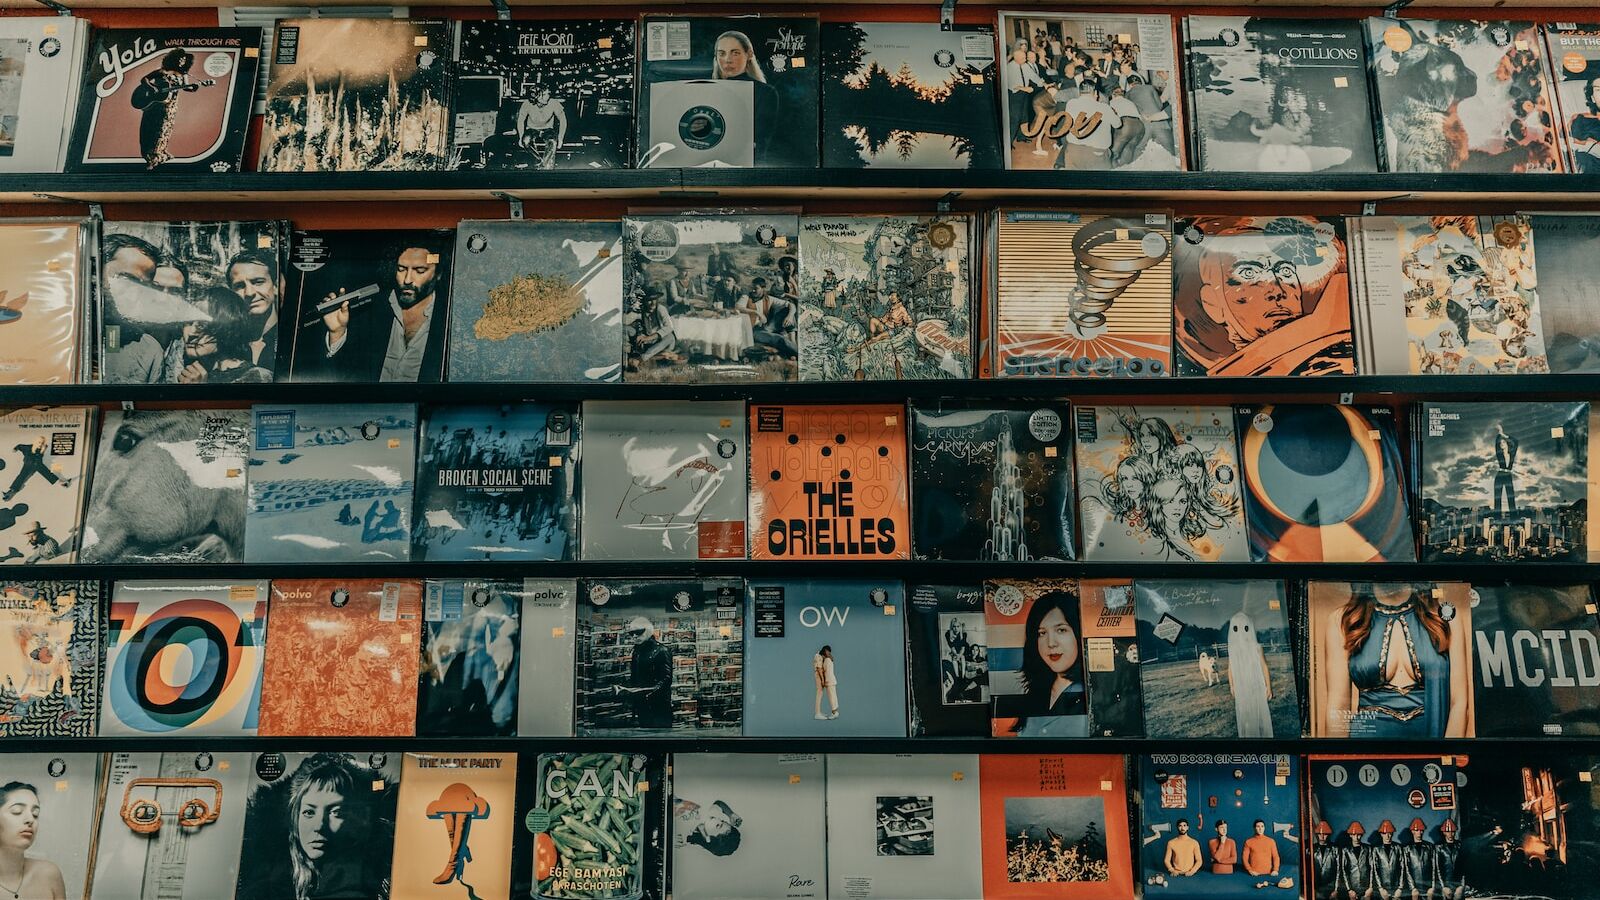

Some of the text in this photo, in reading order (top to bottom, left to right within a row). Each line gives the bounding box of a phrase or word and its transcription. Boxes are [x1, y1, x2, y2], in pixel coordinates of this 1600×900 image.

[518, 33, 574, 46] PETE YORN
[777, 26, 806, 43] Silver
[225, 38, 241, 46] FIRE
[765, 37, 807, 56] Tongue
[1560, 38, 1583, 46] BUT
[1278, 47, 1358, 60] COTILLIONS
[96, 37, 157, 97] Yola
[823, 223, 850, 231] PARADE
[49, 413, 81, 424] MIRAGE
[205, 416, 231, 426] Bonny
[926, 427, 984, 439] PICKUPS
[438, 468, 553, 486] BROKEN SOCIAL SCENE
[803, 481, 854, 518] THE
[768, 517, 896, 556] ORIELLES
[282, 588, 312, 600] polvo
[999, 589, 1021, 610] 2019
[799, 606, 850, 627] OW
[1096, 616, 1122, 627] CENTER
[1475, 629, 1600, 688] MCID
[419, 758, 438, 768] THE
[469, 758, 503, 768] PARTY
[1150, 753, 1179, 764] TWO
[1179, 753, 1213, 764] DOOR
[1213, 753, 1259, 764] CINEMA
[545, 768, 635, 798] CAN
[549, 866, 626, 879] EGE BAMYASI
[788, 874, 815, 889] Rare
